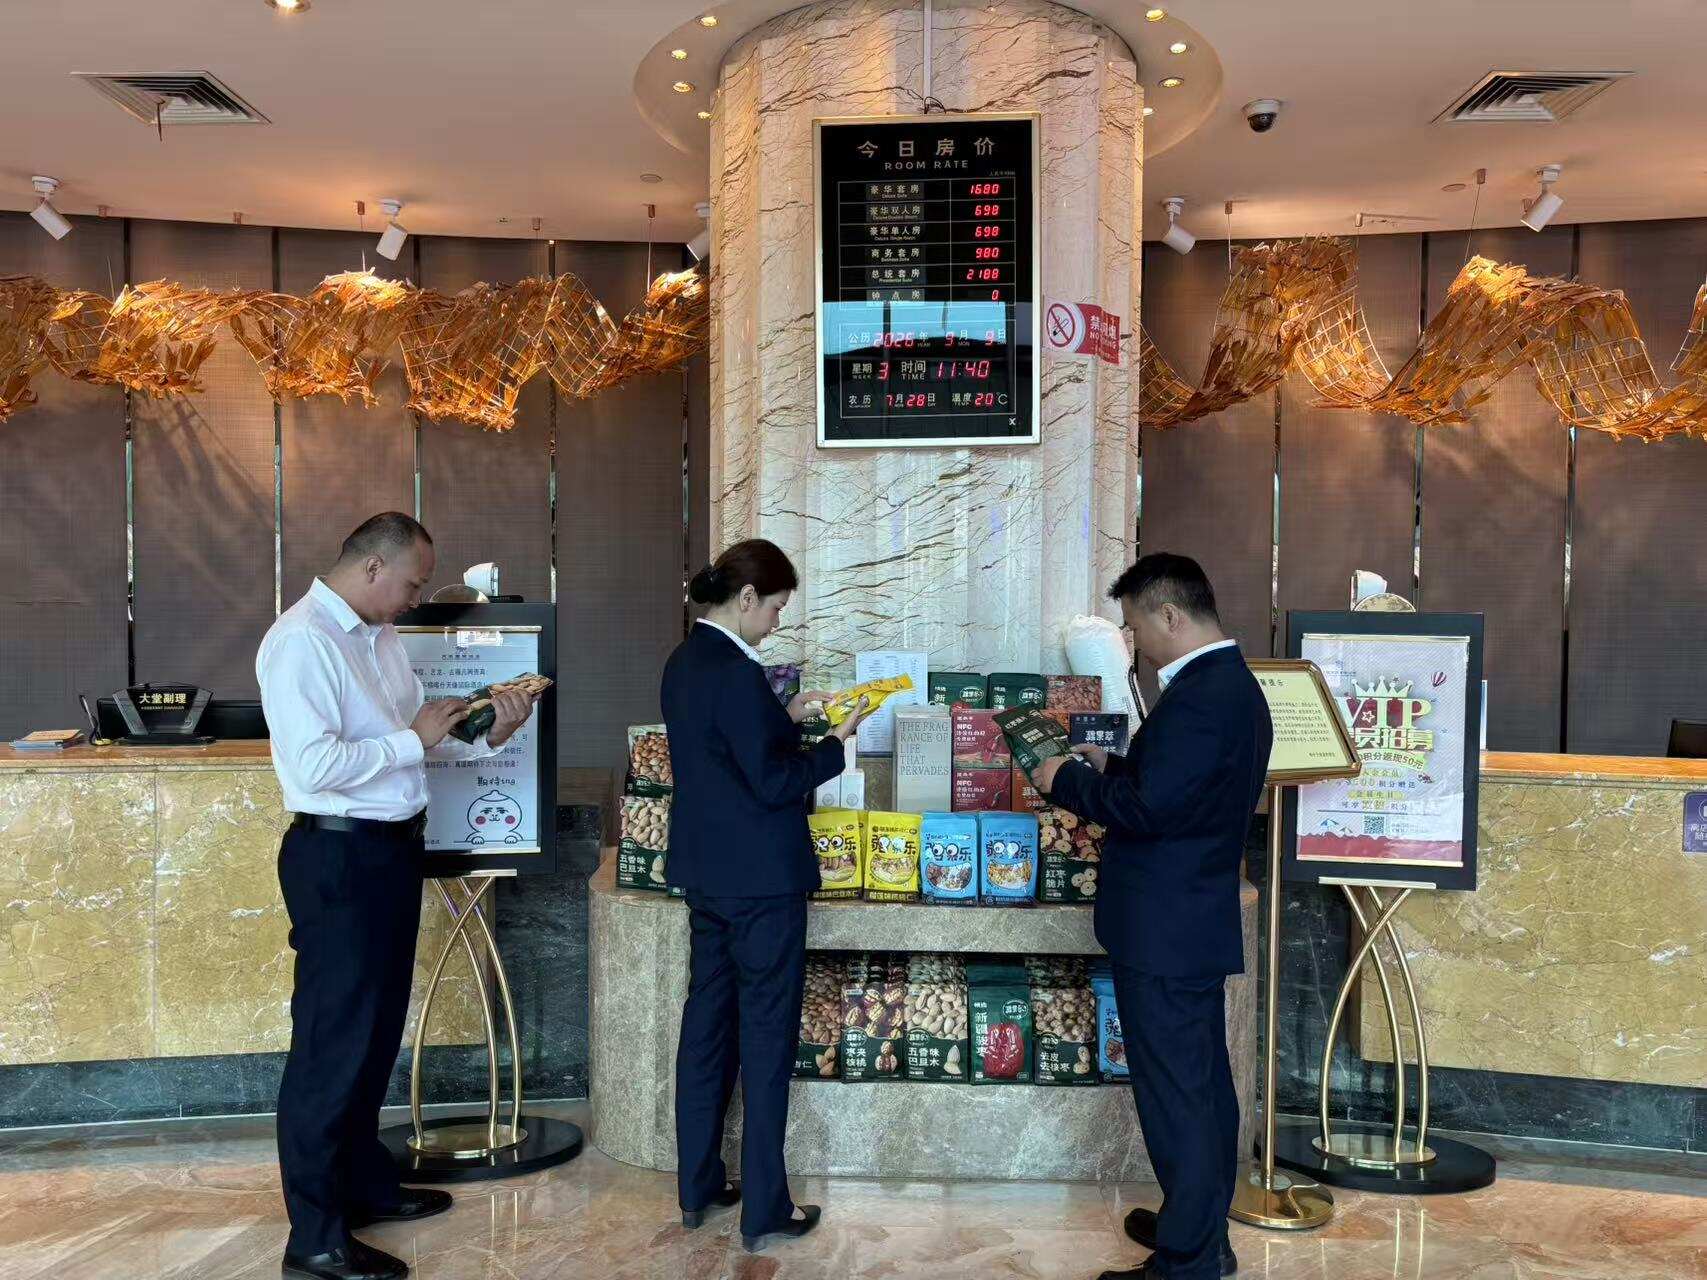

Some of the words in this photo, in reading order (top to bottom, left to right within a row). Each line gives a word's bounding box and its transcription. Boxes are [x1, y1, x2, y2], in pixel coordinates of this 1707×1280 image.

[857, 137, 995, 158] 今日房价
[884, 160, 926, 170] ROOM
[934, 159, 969, 169] RATE
[870, 184, 920, 195] 豪华套房
[970, 183, 1000, 195] 1680
[870, 204, 921, 216] 豪华双人房
[974, 204, 1000, 216] 698
[870, 225, 921, 236] 豪华单人房
[974, 226, 1000, 237] 698
[975, 247, 1000, 259] 980
[966, 268, 1000, 280] 2188
[991, 289, 1000, 301] 0
[848, 332, 871, 344] 公历
[851, 362, 873, 374] 星期
[877, 362, 889, 380] 3
[901, 360, 926, 374] 时间
[936, 359, 990, 378] 11:40
[848, 394, 872, 405] 农历
[886, 394, 894, 406] 7
[906, 394, 926, 407] 28
[951, 392, 972, 403] 温度
[974, 393, 994, 406] 20
[139, 693, 187, 705] 大堂副理
[1334, 697, 1432, 730] VIP
[900, 721, 922, 731] THE
[900, 732, 932, 742] RANCE
[1347, 727, 1433, 751] 员招募
[900, 754, 925, 764] THAT
[900, 765, 949, 775] PERVADES
[619, 855, 647, 865] 五香味
[619, 863, 647, 874] 巴旦木
[907, 1047, 940, 1057] 五香味
[846, 1057, 867, 1067] 核桃
[907, 1057, 940, 1067] 巴旦木
